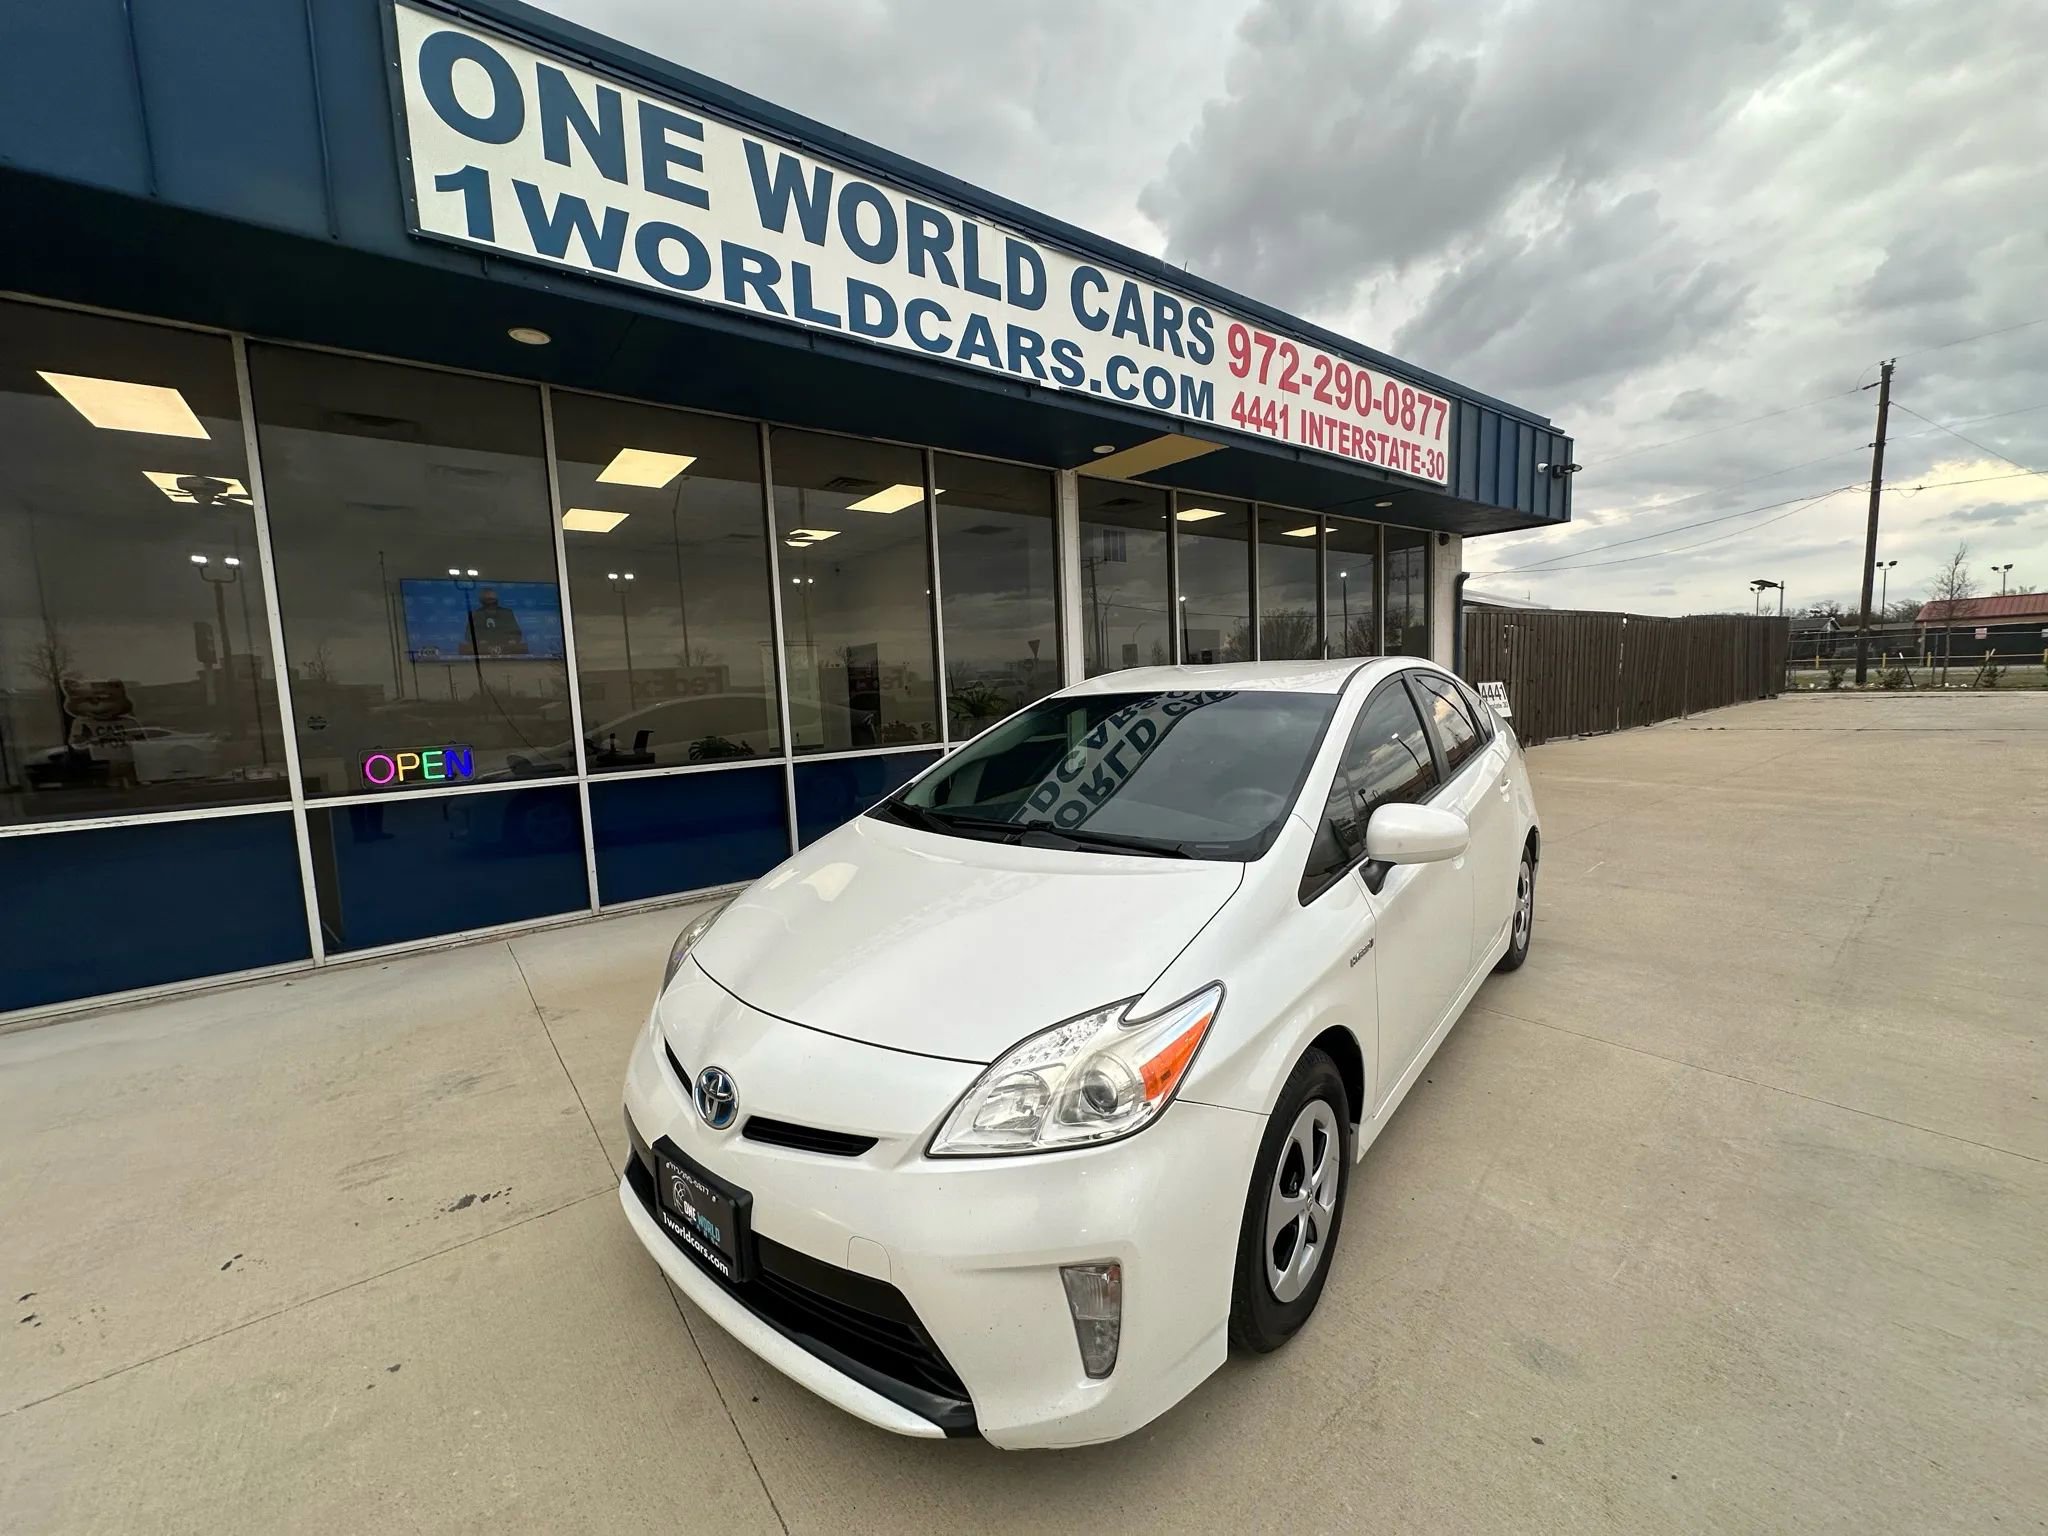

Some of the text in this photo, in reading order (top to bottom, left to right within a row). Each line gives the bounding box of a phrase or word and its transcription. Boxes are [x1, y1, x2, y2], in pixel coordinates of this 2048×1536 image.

[418, 30, 1215, 366] ONE WORLD CARS
[434, 164, 1215, 422] 1WORLDCARS.COM
[1228, 322, 1449, 441] 972-290-0877
[1231, 390, 1446, 481] 4441 INTERSTATE-30
[1481, 684, 1506, 701] 4441
[365, 749, 473, 784] OPEN
[662, 1212, 729, 1277] 1worldcars.com
